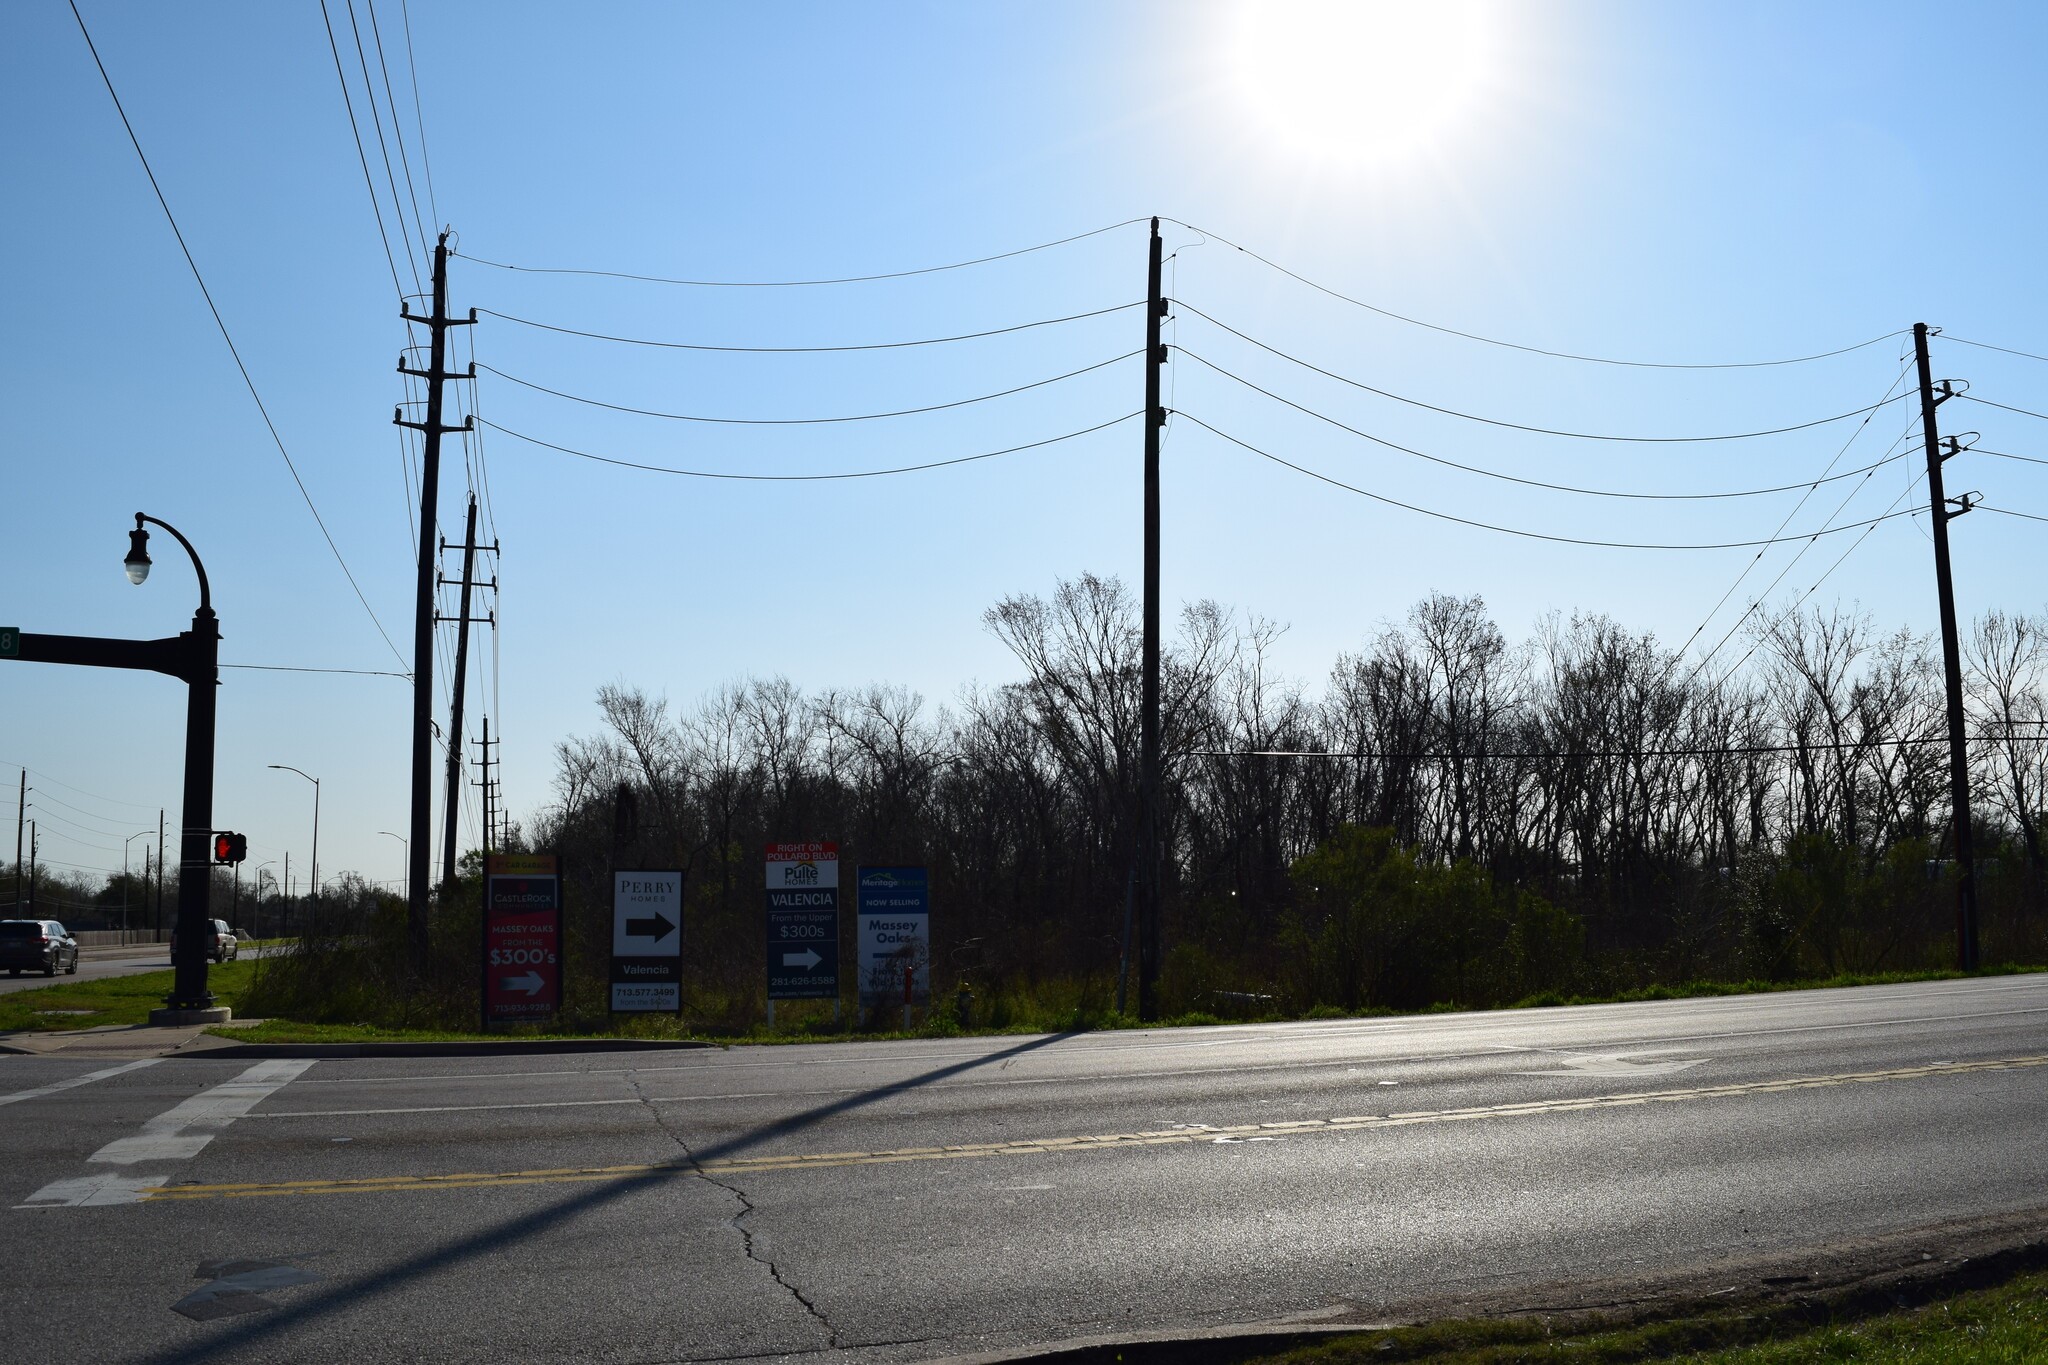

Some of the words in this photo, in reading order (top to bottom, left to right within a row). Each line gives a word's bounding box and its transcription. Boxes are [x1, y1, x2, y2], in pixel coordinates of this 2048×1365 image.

[777, 844, 806, 852] RIGHT
[808, 843, 823, 851] ON
[767, 852, 810, 861] POLLARD
[812, 852, 836, 860] BLVD
[785, 866, 818, 879] Pulte
[620, 880, 675, 893] PERRY
[771, 893, 833, 906] VALENCIA
[866, 899, 887, 907] NOW
[889, 898, 920, 906] SELLING
[771, 914, 792, 922] From
[793, 913, 807, 921] the
[809, 913, 833, 922] Upper
[492, 925, 528, 934] MASSEY
[529, 924, 554, 933] OAKS
[869, 919, 918, 933] Massey
[780, 925, 825, 939] $300s
[528, 938, 543, 946] THE
[876, 932, 911, 944] Oaks
[490, 948, 556, 967] $300's
[623, 964, 669, 975] Valencia
[771, 976, 836, 986] 281-626-5588
[616, 988, 675, 996] 713.577.3499
[620, 998, 636, 1006] from
